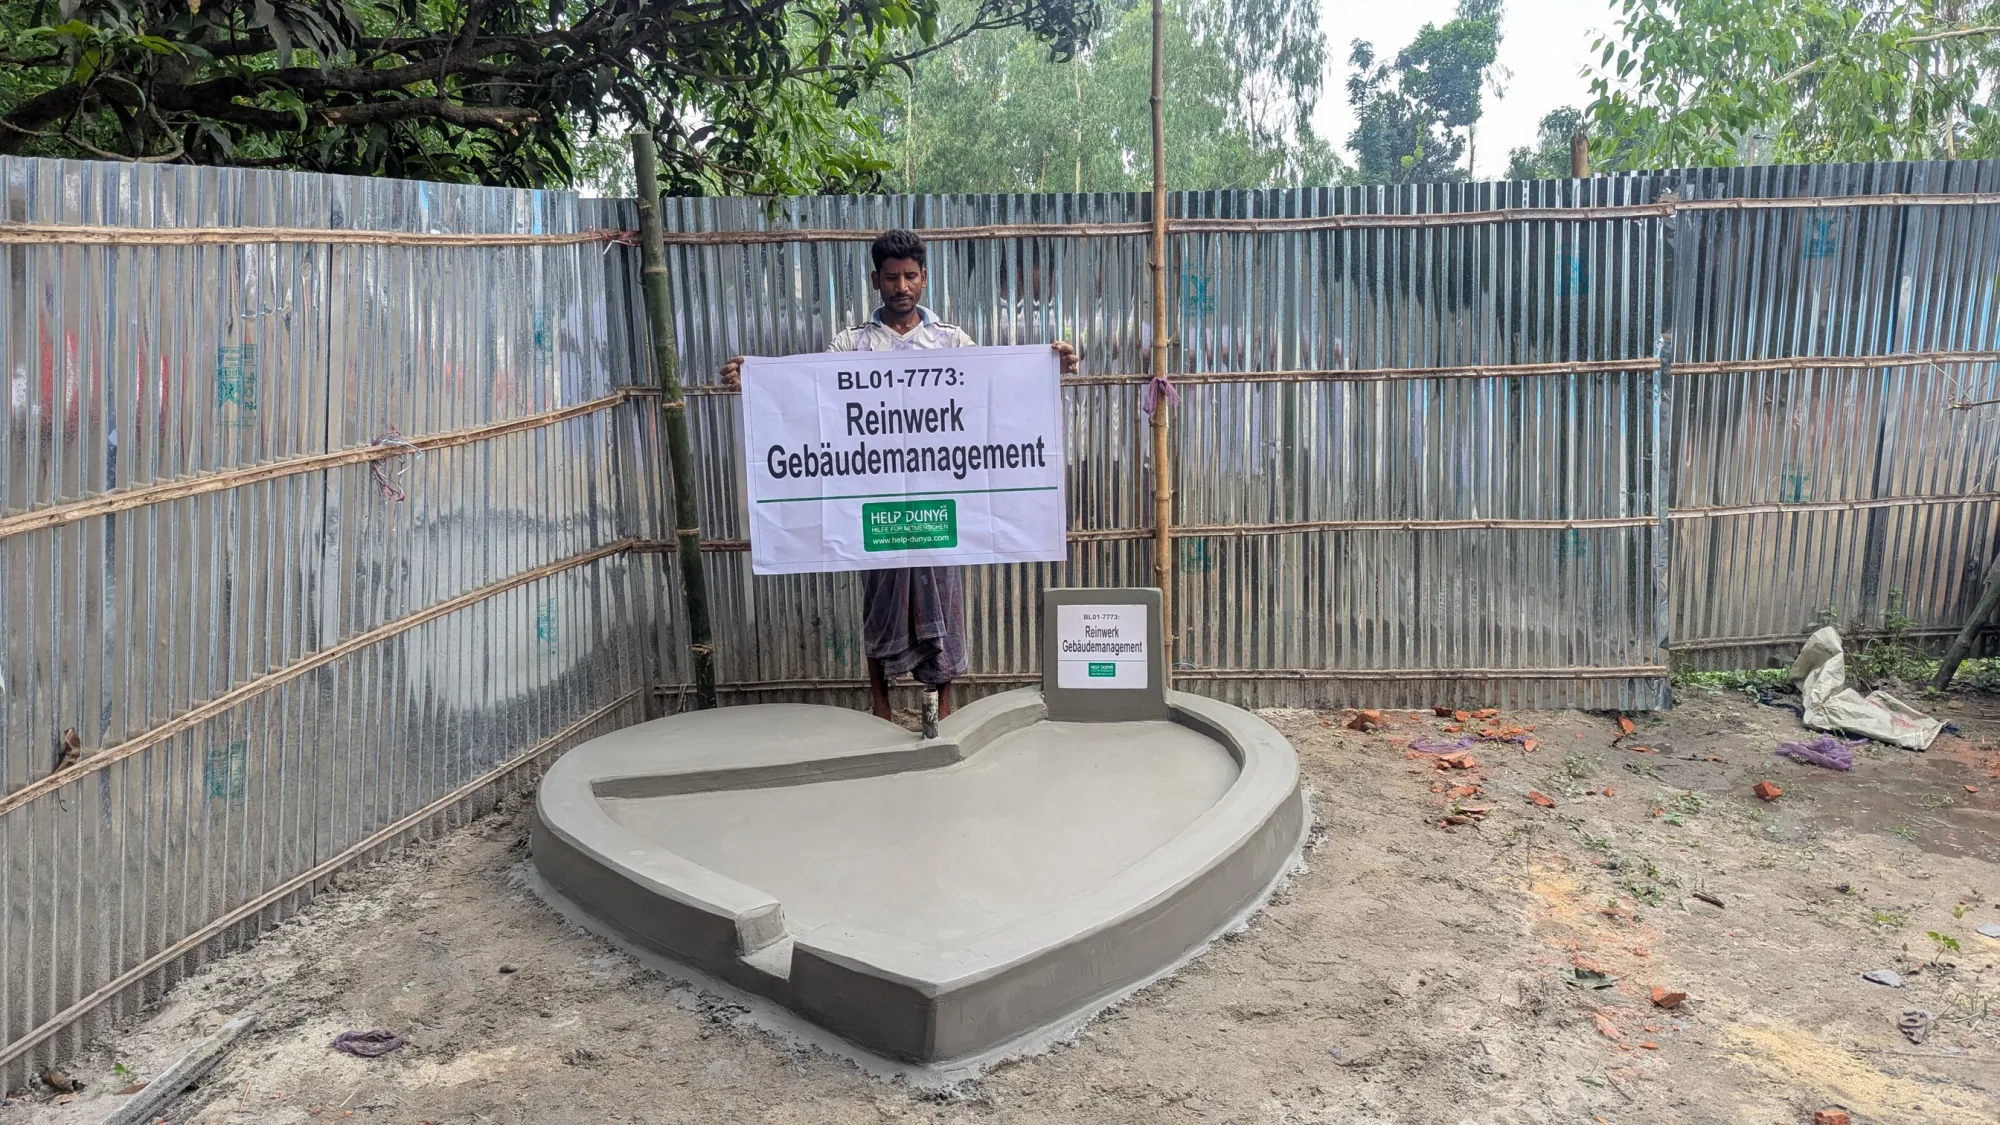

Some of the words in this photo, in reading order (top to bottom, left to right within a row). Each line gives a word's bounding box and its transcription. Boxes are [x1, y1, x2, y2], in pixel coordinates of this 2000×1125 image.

[837, 367, 966, 390] BL01-7773:
[846, 398, 965, 436] Reinwerk
[767, 435, 1046, 480] Gebäudemanagement
[871, 511, 902, 525] HELP
[873, 535, 949, 544] www.help-dunya.com
[1085, 625, 1119, 638] Reinwerk
[1062, 640, 1143, 656] Gebäudemanagement
